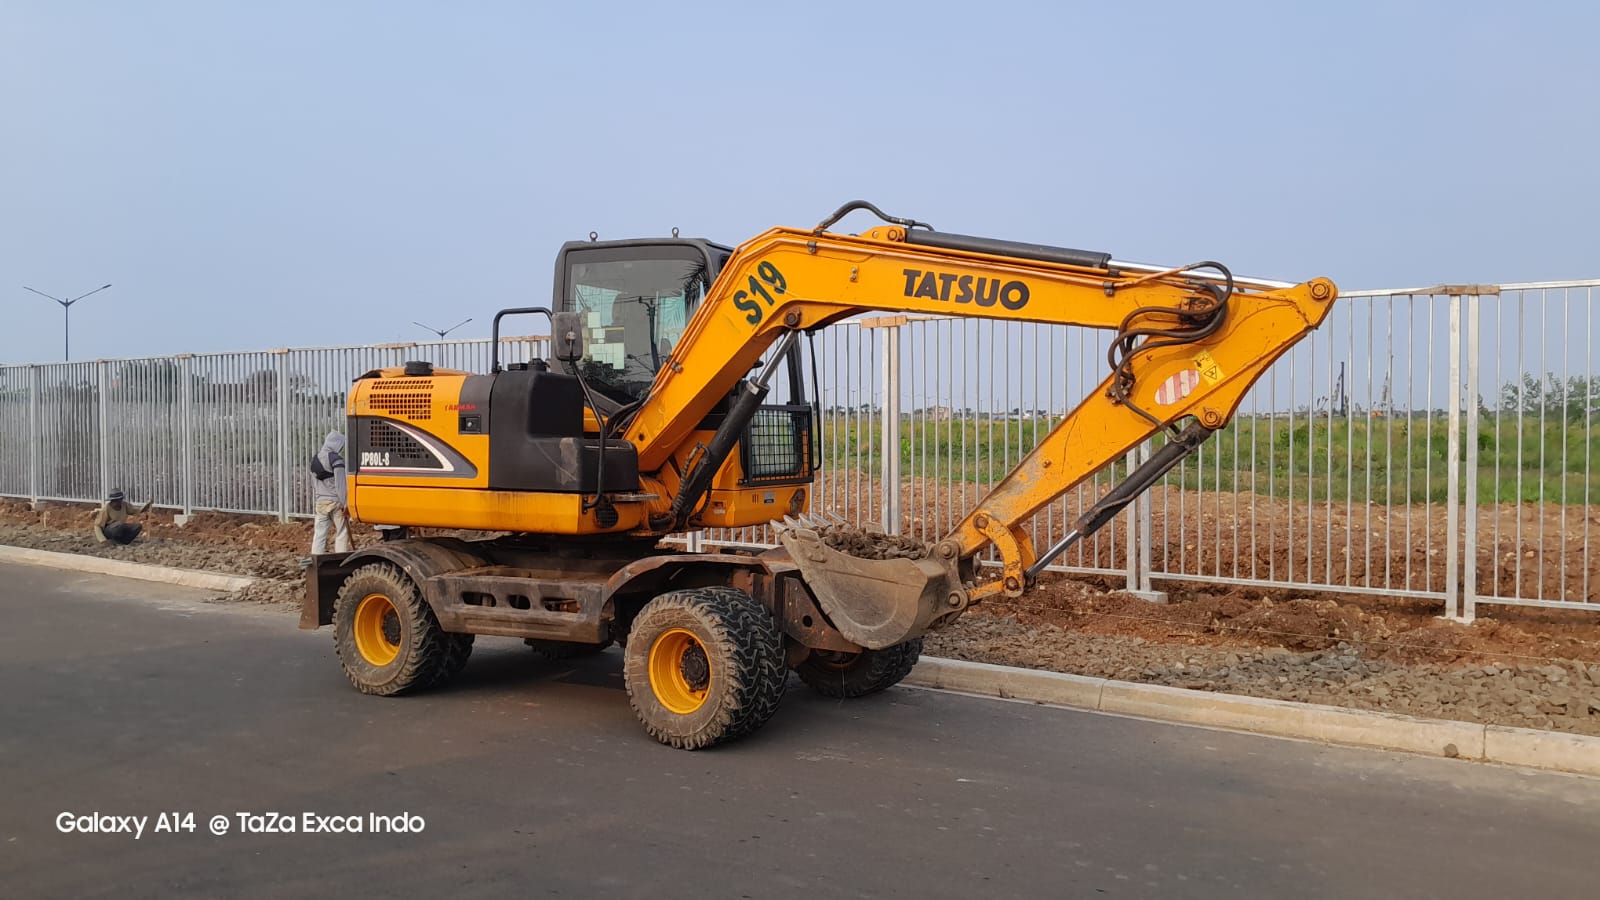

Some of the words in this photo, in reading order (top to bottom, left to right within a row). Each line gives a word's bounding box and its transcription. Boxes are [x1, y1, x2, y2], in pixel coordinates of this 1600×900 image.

[733, 261, 787, 325] S19
[902, 268, 1031, 311] TATSUO
[360, 452, 390, 466] JP80L-8
